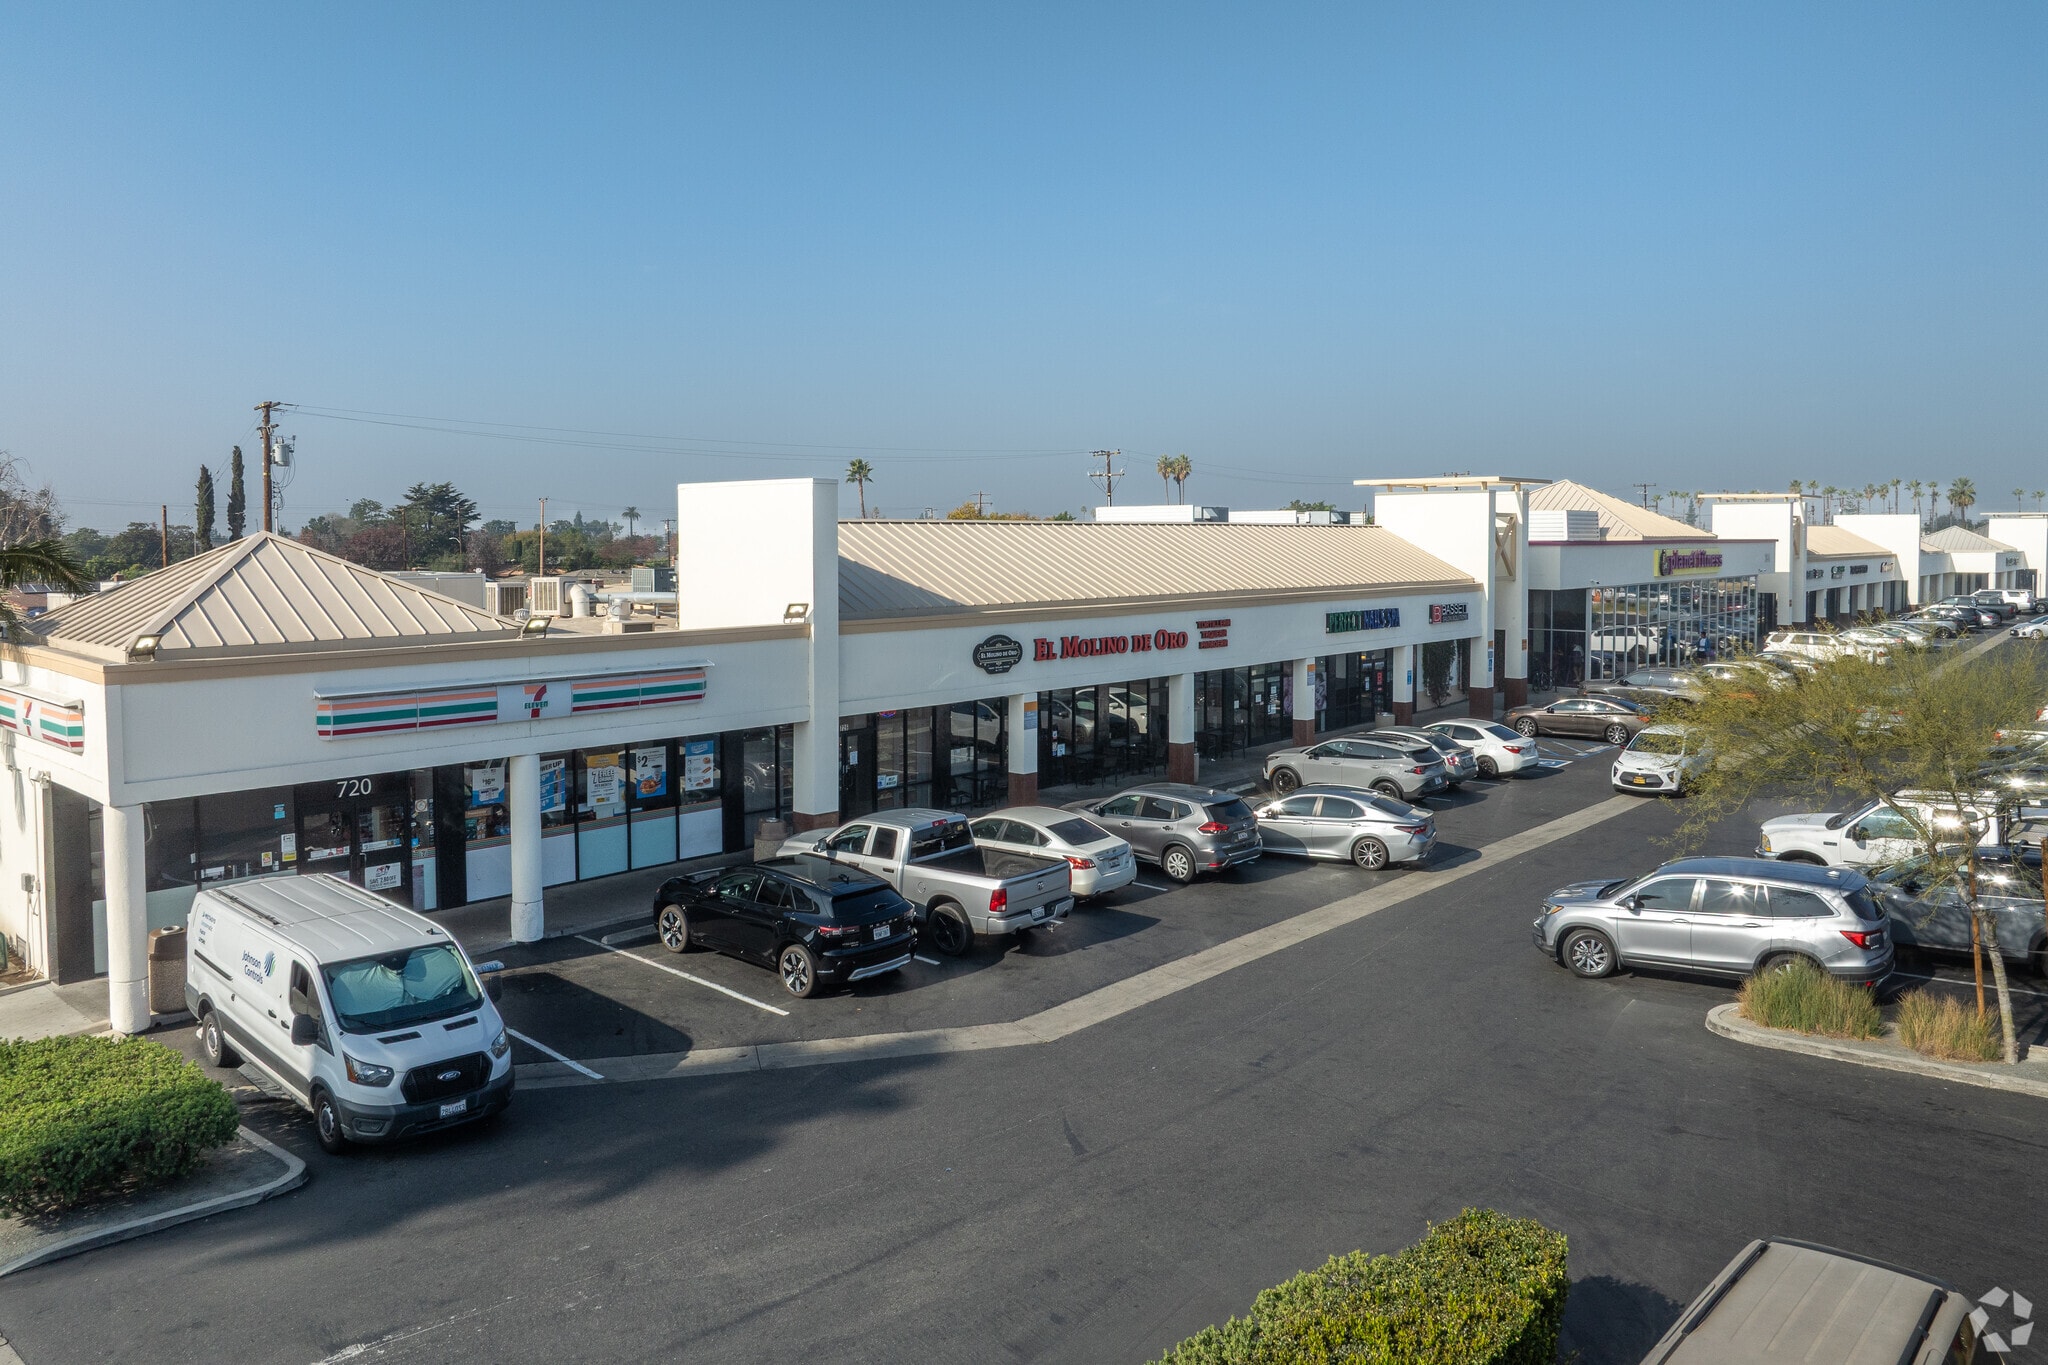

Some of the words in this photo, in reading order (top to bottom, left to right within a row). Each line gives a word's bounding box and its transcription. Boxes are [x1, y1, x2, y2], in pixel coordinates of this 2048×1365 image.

[1667, 550, 1694, 575] planet
[1695, 549, 1723, 568] fitness
[1327, 610, 1362, 633] PERFECT
[1034, 638, 1057, 661] EL
[1060, 635, 1129, 659] MOLINO
[1131, 634, 1152, 653] DE
[1154, 628, 1188, 651] ORO
[523, 684, 548, 719] 7
[336, 778, 372, 798] 720
[242, 950, 262, 969] Johnson
[244, 964, 264, 985] Controls
